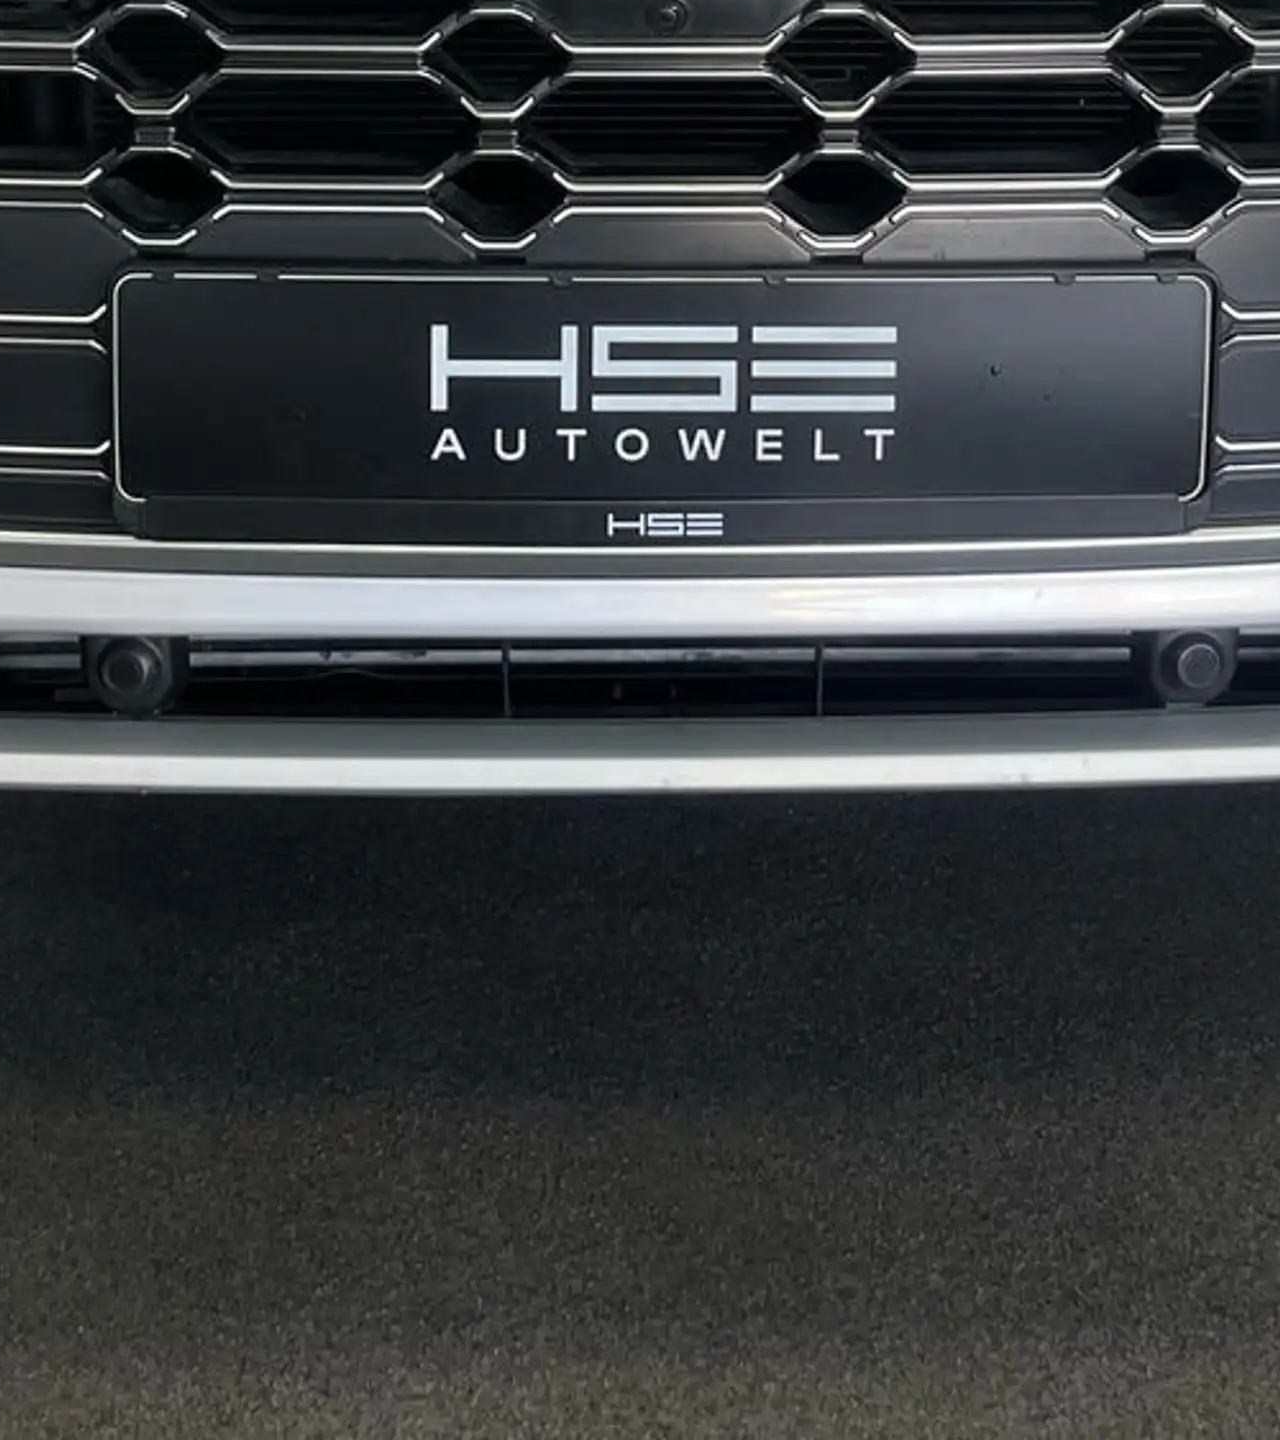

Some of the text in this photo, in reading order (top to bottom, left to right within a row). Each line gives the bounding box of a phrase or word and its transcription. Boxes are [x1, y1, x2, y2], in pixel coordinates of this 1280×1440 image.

[430, 324, 898, 413] HSE
[430, 427, 897, 462] AUTOWELT
[607, 512, 725, 537] HSE
